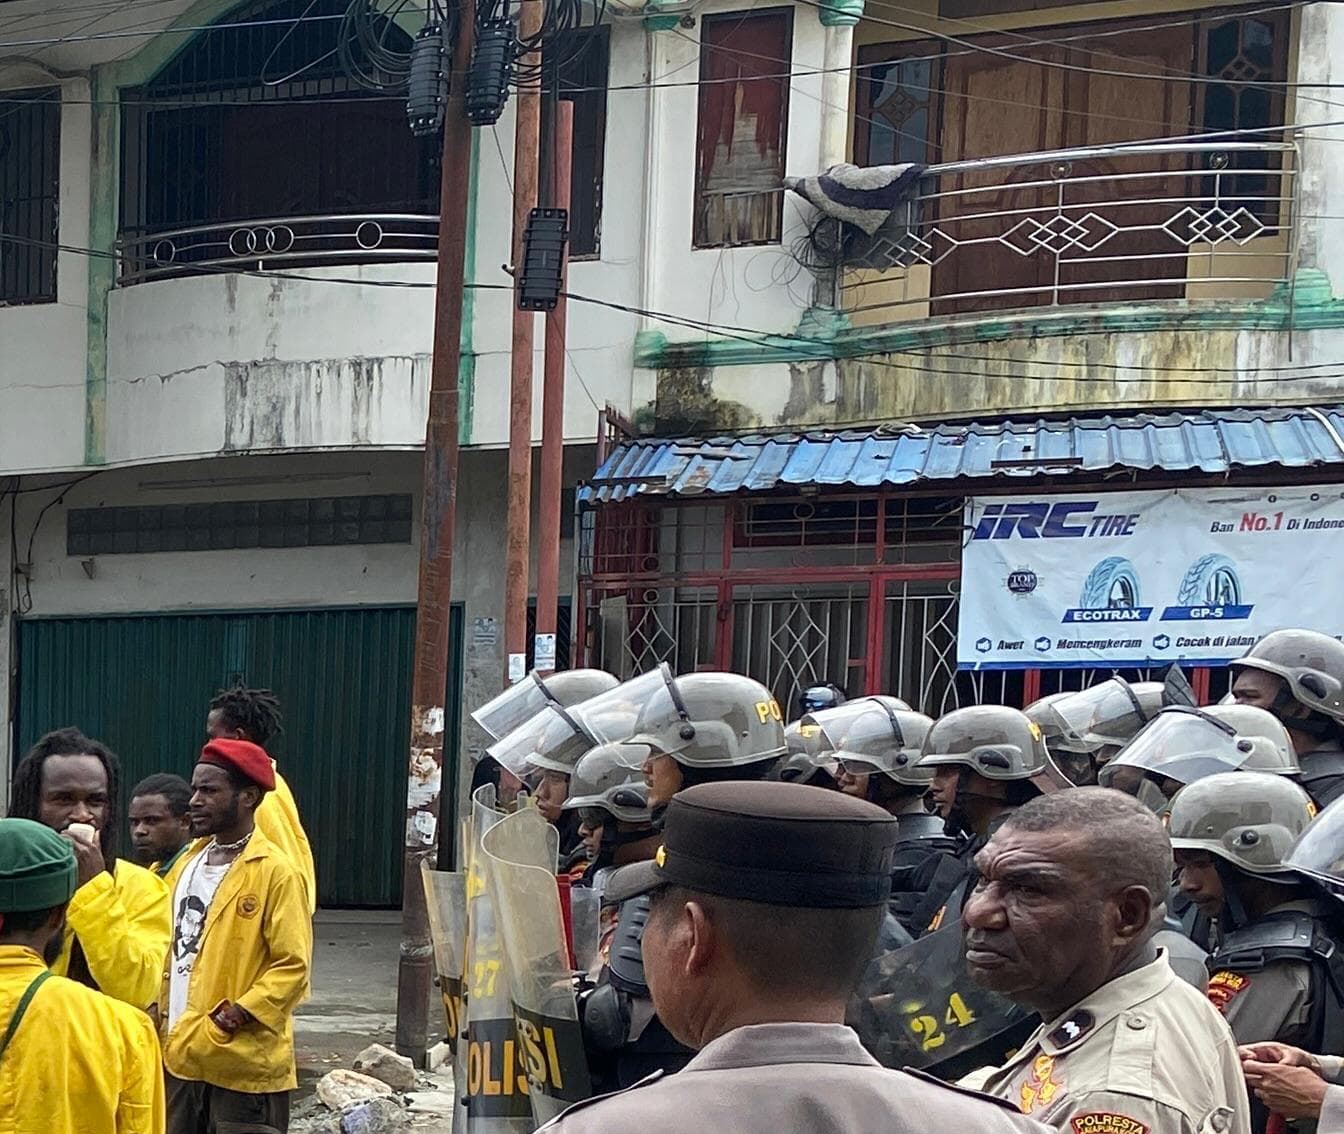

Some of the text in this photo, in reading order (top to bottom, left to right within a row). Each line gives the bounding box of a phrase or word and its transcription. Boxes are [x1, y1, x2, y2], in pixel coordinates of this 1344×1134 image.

[1088, 514, 1140, 537] TIRE
[1210, 511, 1344, 533] Ban No.1 Di Indone
[1073, 609, 1141, 621] ECOTRAX
[1190, 607, 1224, 618] GP-5
[997, 637, 1142, 651] Awet Mencengkeram
[1176, 635, 1255, 648] Cocok di jalan
[910, 992, 976, 1051] 24
